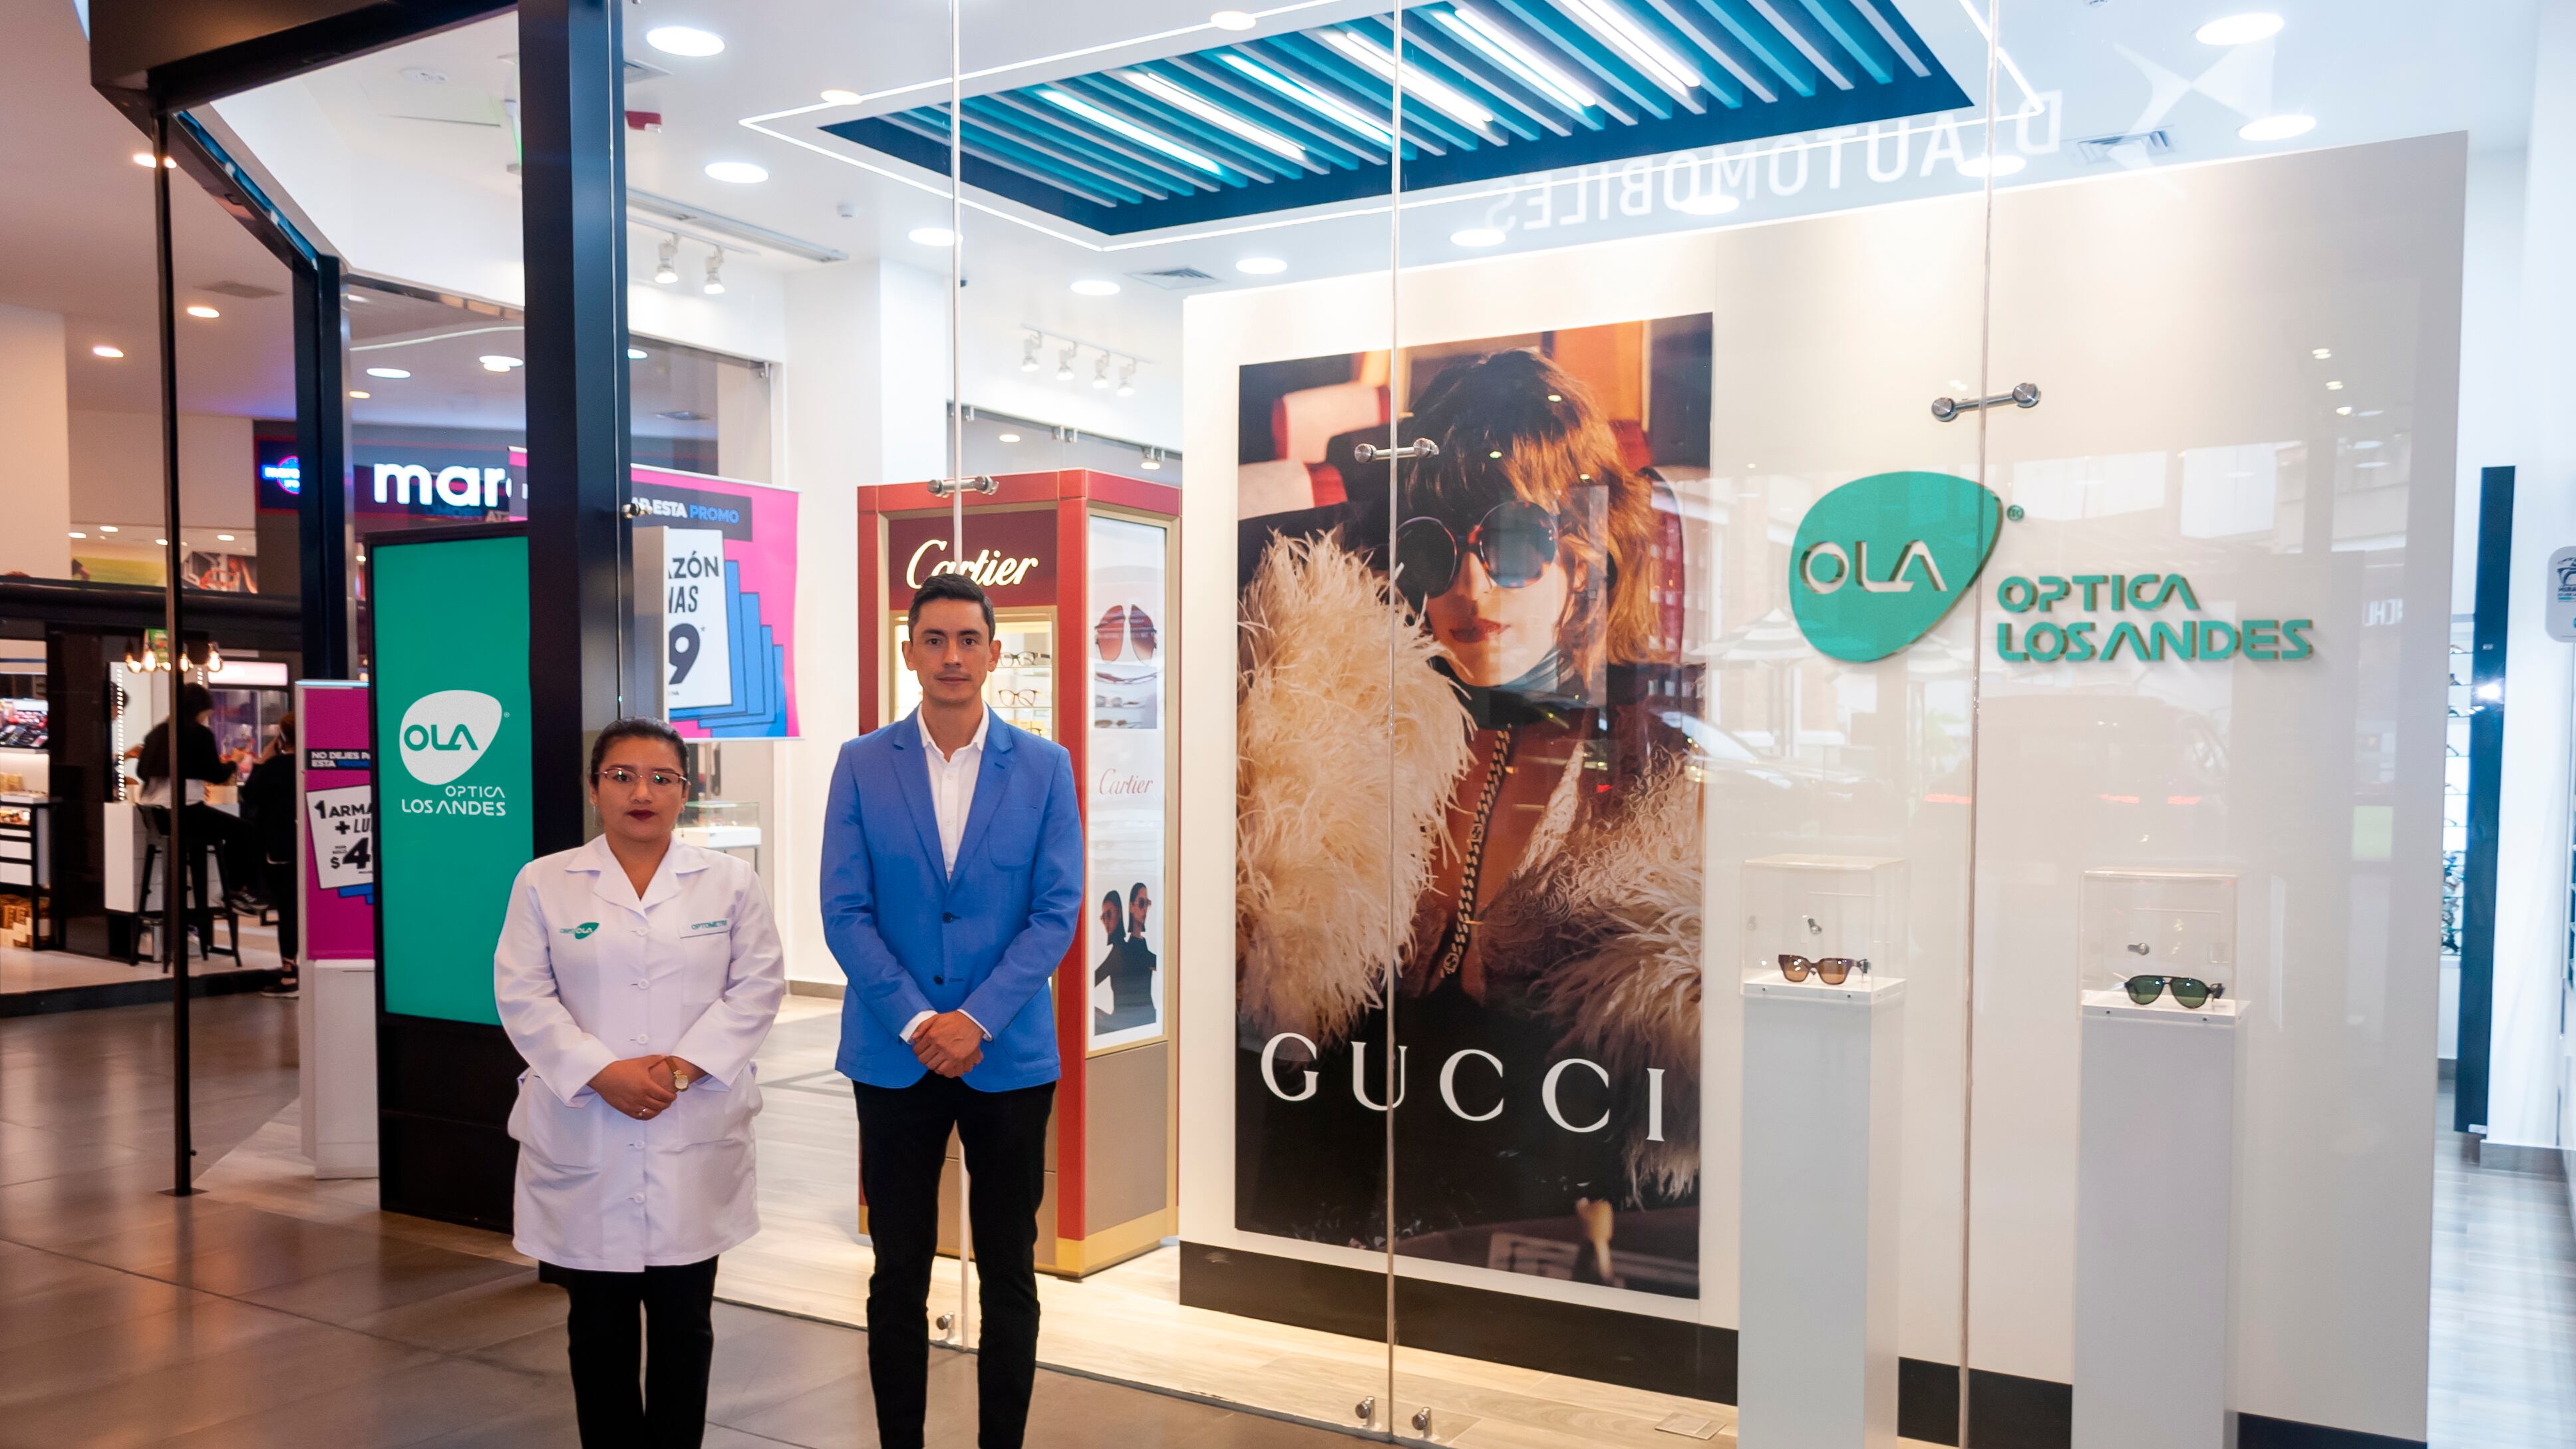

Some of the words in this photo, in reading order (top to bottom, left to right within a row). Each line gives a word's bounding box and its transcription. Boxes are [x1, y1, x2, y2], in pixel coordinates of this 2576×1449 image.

[374, 464, 512, 508] mar
[653, 500, 688, 518] ESTA
[689, 504, 740, 524] PROMO
[669, 550, 719, 579] ZÓN
[906, 539, 1039, 589] Cartier
[1799, 540, 1948, 593] OLA
[1997, 573, 2199, 613] OPTICA
[404, 723, 478, 752] OLA
[445, 786, 506, 798] OPTICA
[1099, 768, 1154, 795] Cartier
[315, 800, 326, 819] 1
[353, 818, 373, 834] LU
[1260, 1032, 1665, 1142] GUCCI
